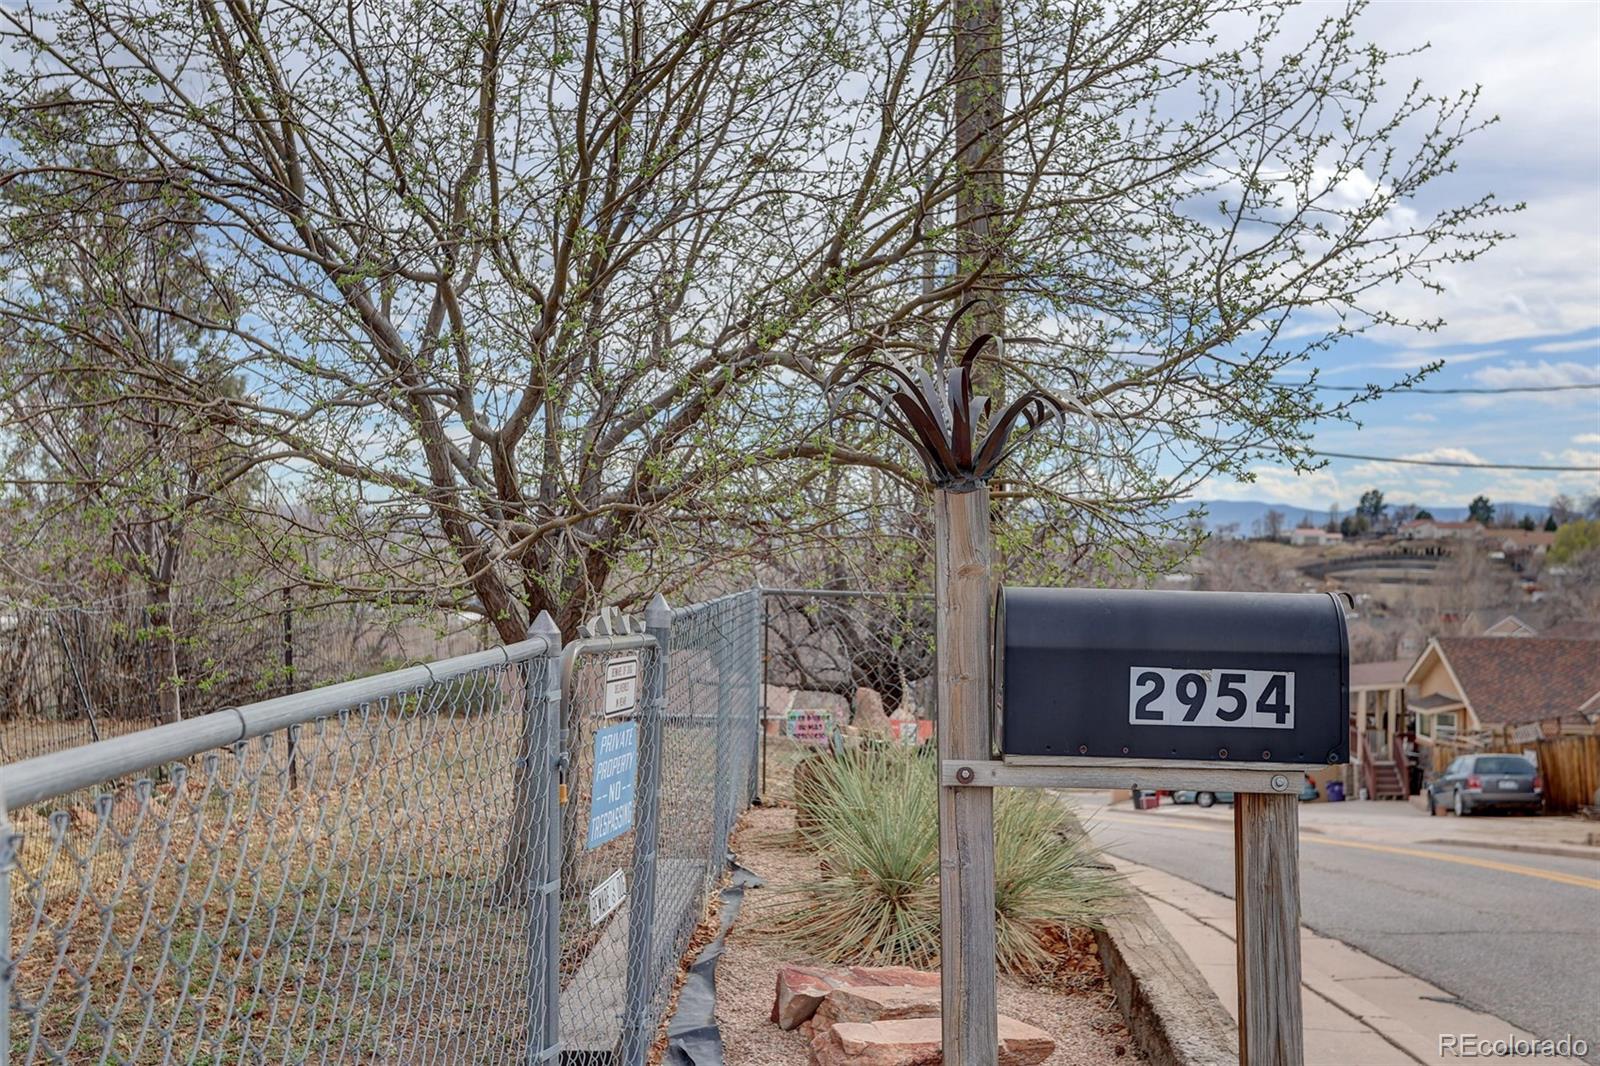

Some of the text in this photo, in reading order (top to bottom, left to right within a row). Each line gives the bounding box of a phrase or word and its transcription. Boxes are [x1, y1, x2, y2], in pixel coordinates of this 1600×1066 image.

[1135, 671, 1290, 725] 2954
[600, 728, 634, 754] PRIVATE
[596, 750, 635, 782] PROPERTY
[591, 801, 632, 841] TRESPASSING
